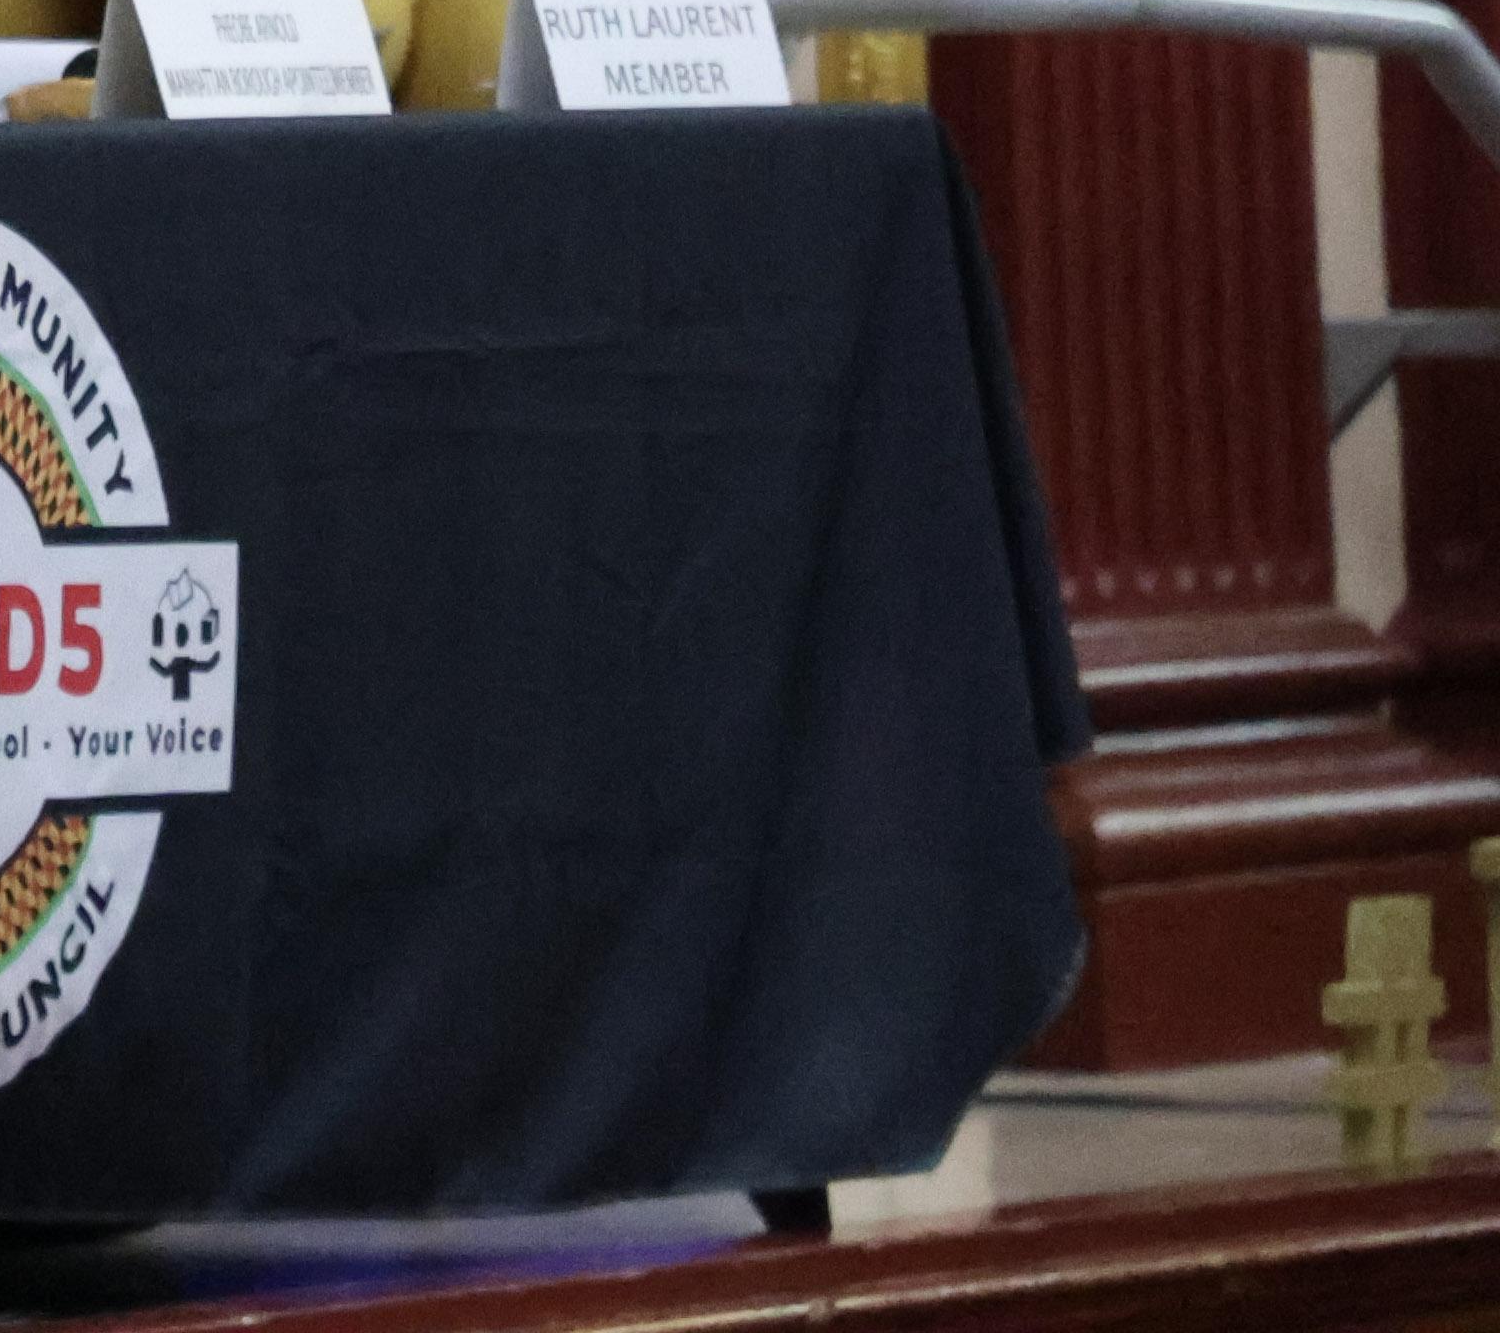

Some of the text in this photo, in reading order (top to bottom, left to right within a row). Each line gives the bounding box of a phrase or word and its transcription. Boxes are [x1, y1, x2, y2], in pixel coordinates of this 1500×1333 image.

[543, 6, 756, 40] RUTH LAURENT
[604, 62, 730, 95] MEMBER
[67, 725, 133, 758] Your
[147, 717, 223, 754] Voice
